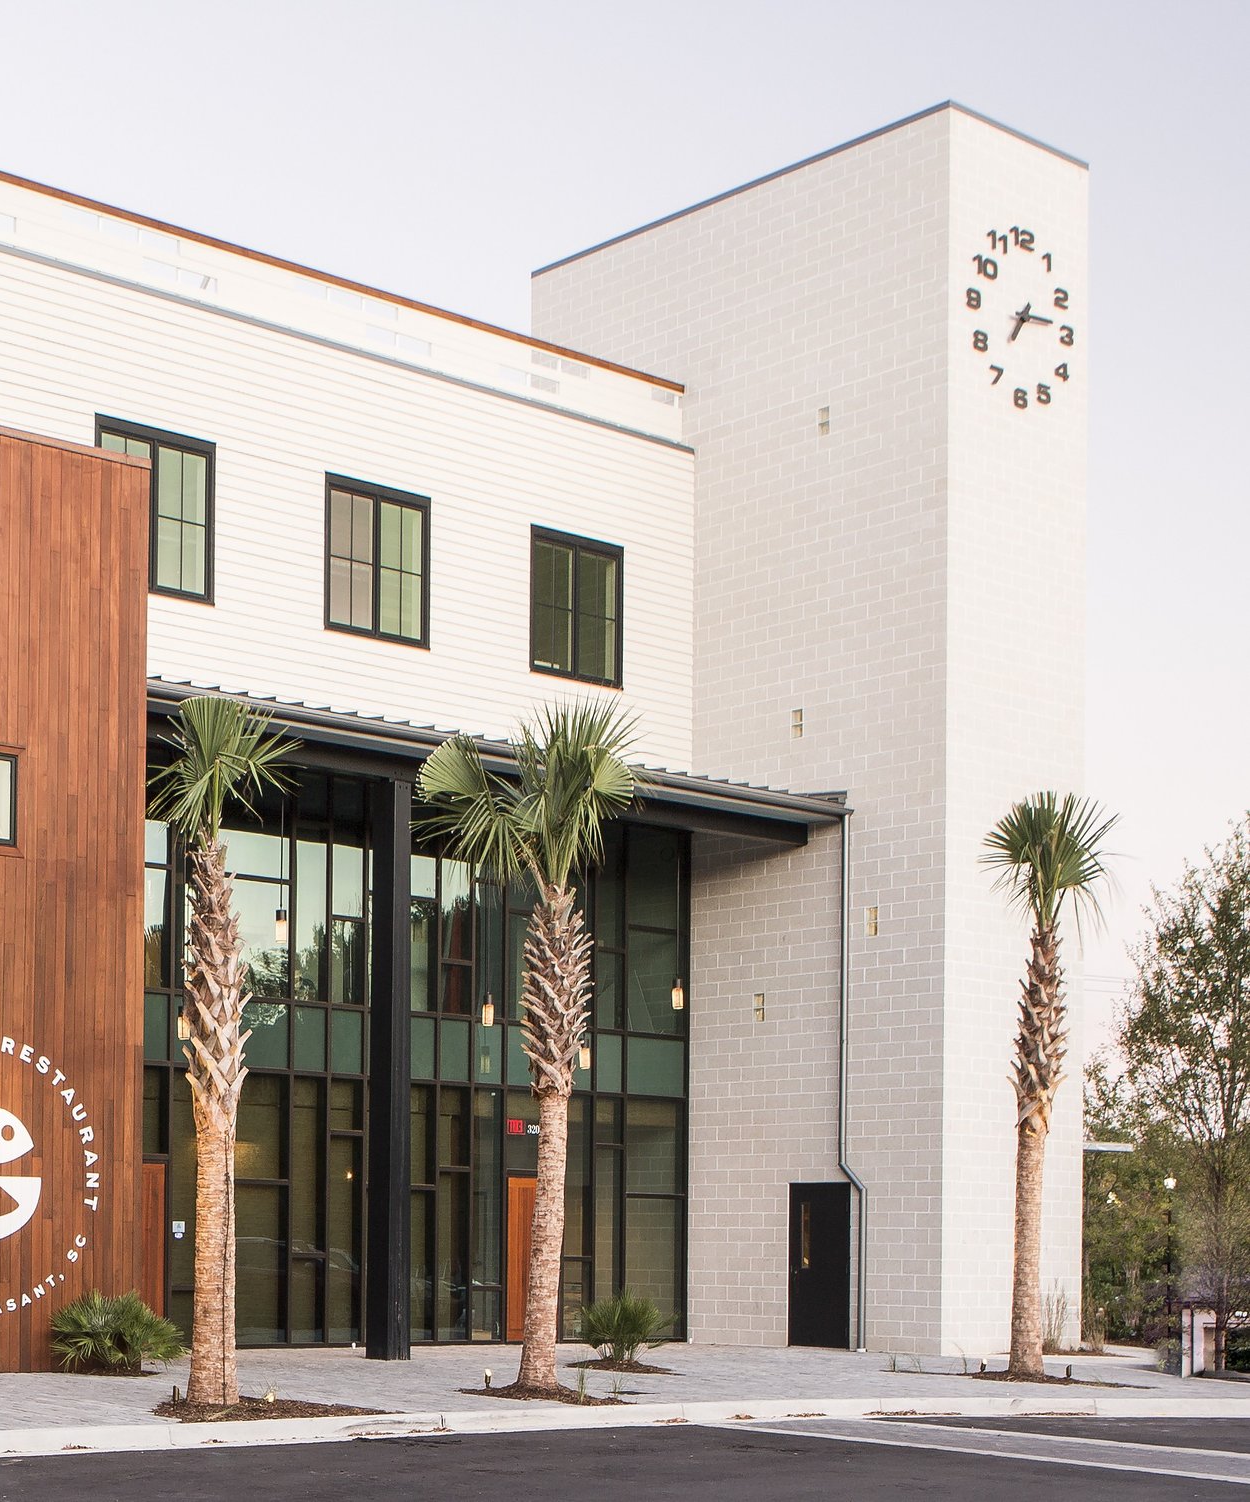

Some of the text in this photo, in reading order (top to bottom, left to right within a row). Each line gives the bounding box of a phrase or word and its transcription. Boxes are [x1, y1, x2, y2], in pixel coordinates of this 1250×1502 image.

[986, 229, 1008, 255] 11
[1009, 225, 1035, 252] 12
[972, 253, 999, 281] 10
[1041, 252, 1052, 273] 1
[966, 287, 982, 310] 9
[1053, 287, 1069, 310] 2
[972, 329, 989, 353] 8
[1059, 324, 1075, 347] 3
[989, 364, 1004, 386] 7
[1054, 362, 1070, 383] 4
[1013, 387, 1028, 410] 6
[1036, 382, 1052, 405] 5
[0, 1036, 100, 1212] RESTAURANT
[66, 1233, 87, 1263] SC
